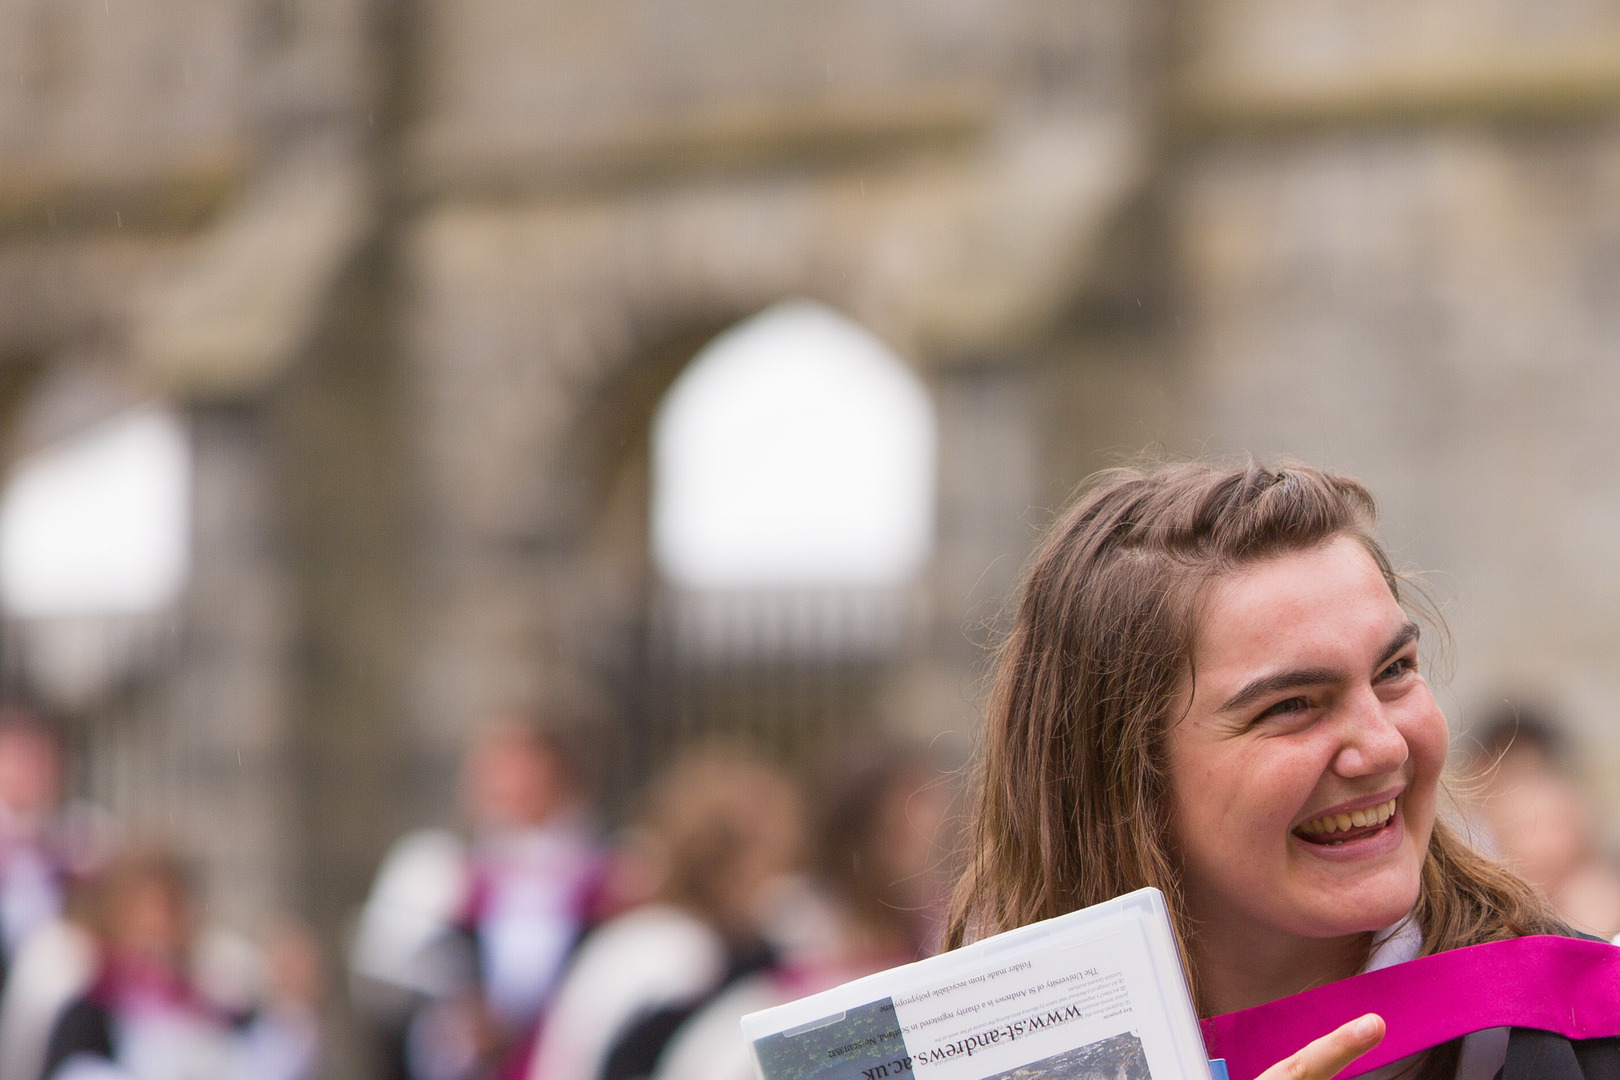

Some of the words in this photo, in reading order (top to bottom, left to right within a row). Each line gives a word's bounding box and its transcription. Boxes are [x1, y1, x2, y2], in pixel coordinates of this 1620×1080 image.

[1008, 961, 1032, 972] Folder
[1084, 967, 1098, 976] The
[968, 975, 986, 984] from
[986, 968, 1007, 979] made
[1045, 973, 1083, 987] University
[932, 982, 966, 996] recyclable
[1036, 984, 1044, 992] of
[879, 991, 930, 1012] polypropylene
[994, 990, 1028, 1003] Andrews
[955, 1005, 980, 1016] charity
[920, 1013, 953, 1029] registered
[877, 1027, 910, 1041] Scotland,
